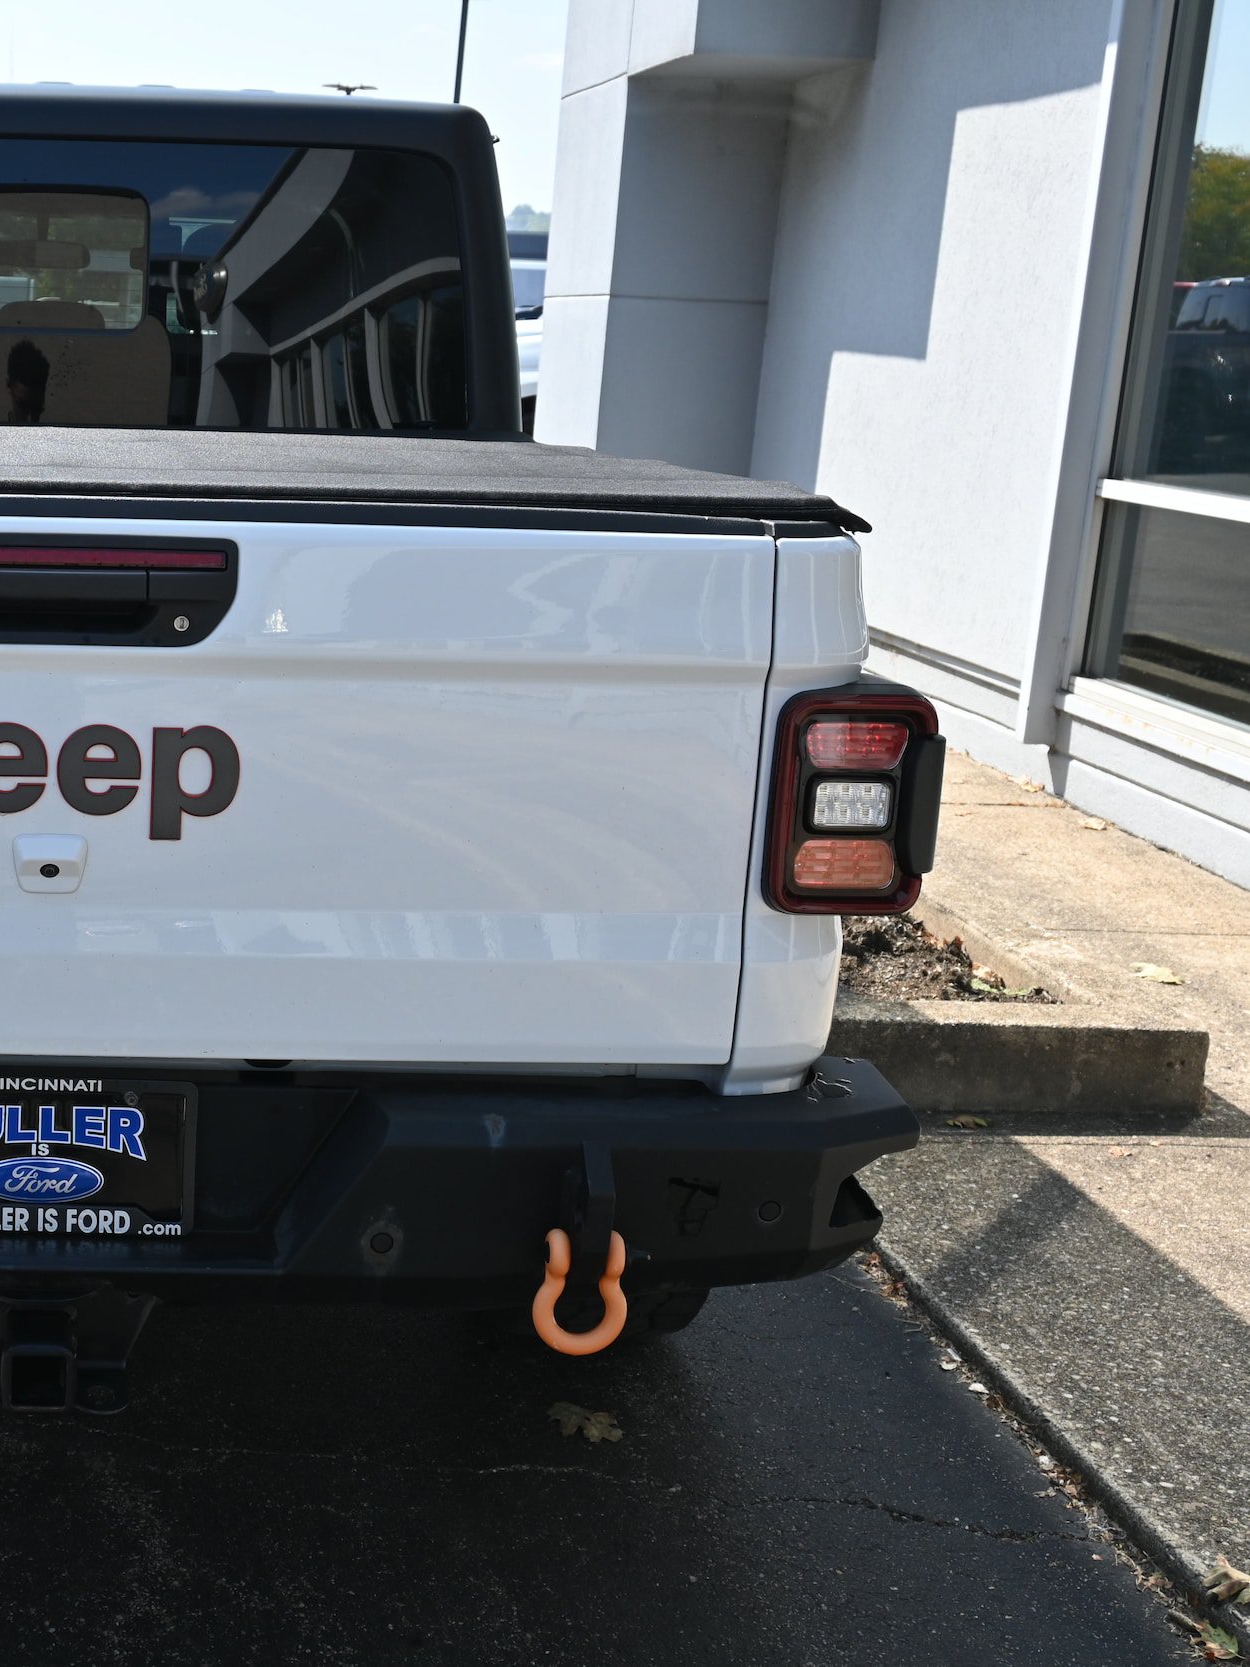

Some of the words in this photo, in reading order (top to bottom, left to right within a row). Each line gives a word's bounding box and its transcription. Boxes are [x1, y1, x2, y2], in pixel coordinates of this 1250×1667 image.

[31, 1143, 50, 1156] IS
[4, 1165, 77, 1194] Ford
[37, 1208, 58, 1233] IS
[66, 1209, 131, 1235] FORD
[137, 1222, 182, 1236] .com
